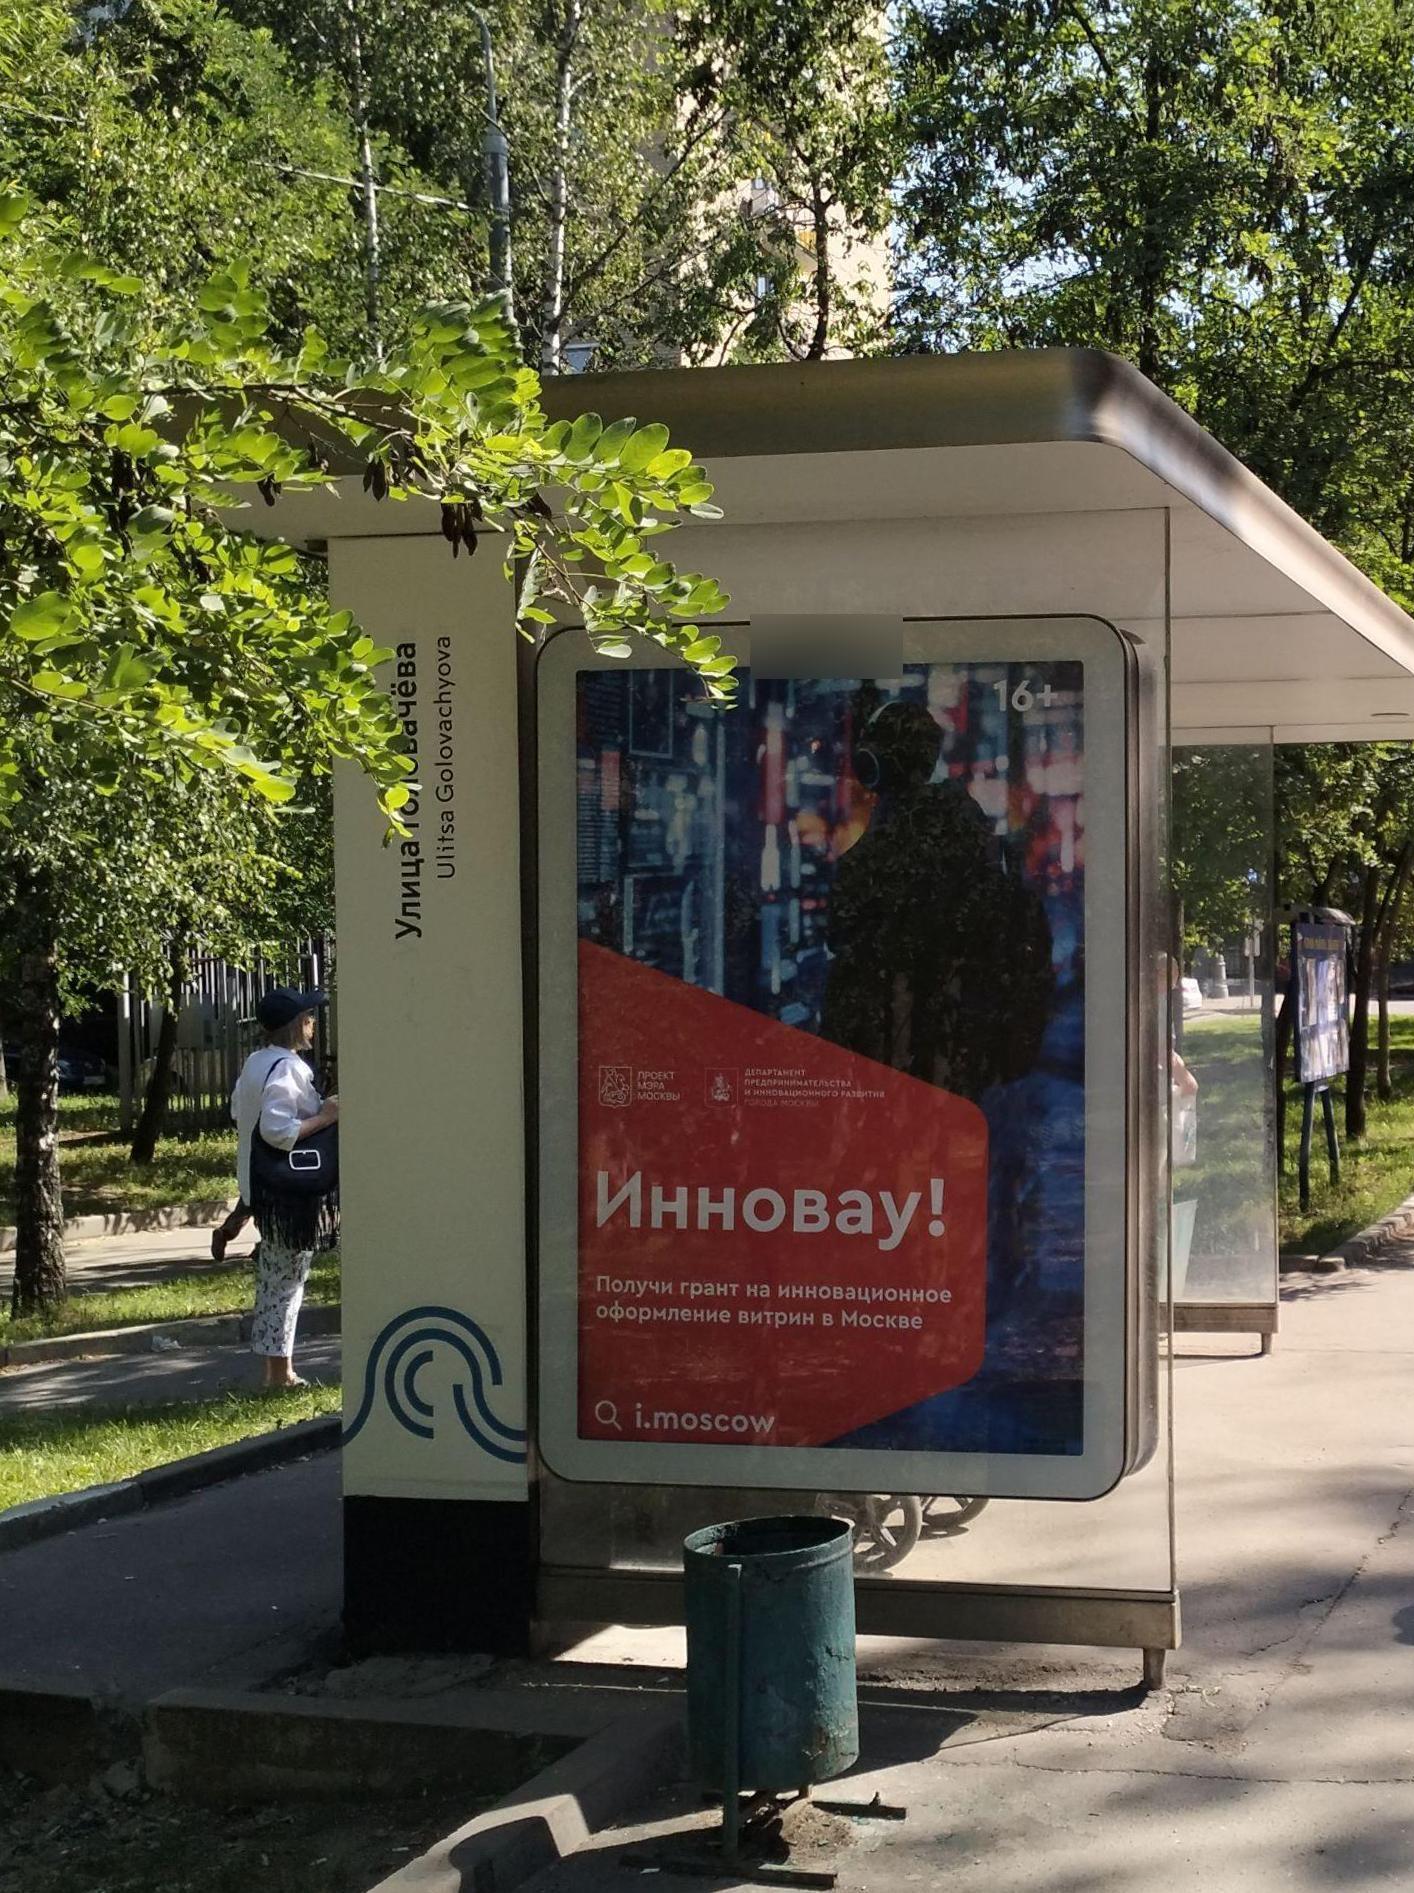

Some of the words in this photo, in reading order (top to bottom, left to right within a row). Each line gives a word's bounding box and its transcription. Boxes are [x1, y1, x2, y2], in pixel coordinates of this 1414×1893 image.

[993, 679, 1058, 712] 16+
[432, 635, 456, 803] Golovachyova
[435, 810, 456, 879] Ulitsa
[394, 841, 425, 940] Улица
[637, 1070, 675, 1081] ПРОЕКТ
[637, 1081, 666, 1091] МЭРА
[637, 1091, 681, 1102] МОСКВЫ
[596, 1169, 946, 1251] Инновау!
[596, 1275, 673, 1298] Получи
[680, 1281, 739, 1300] грант
[746, 1284, 771, 1298] на
[777, 1284, 952, 1304] инновационное
[596, 1300, 731, 1324] оформление
[738, 1310, 815, 1329] витрин
[822, 1312, 835, 1327] в
[841, 1309, 924, 1330] Москве
[635, 1402, 775, 1433] i.moscow
